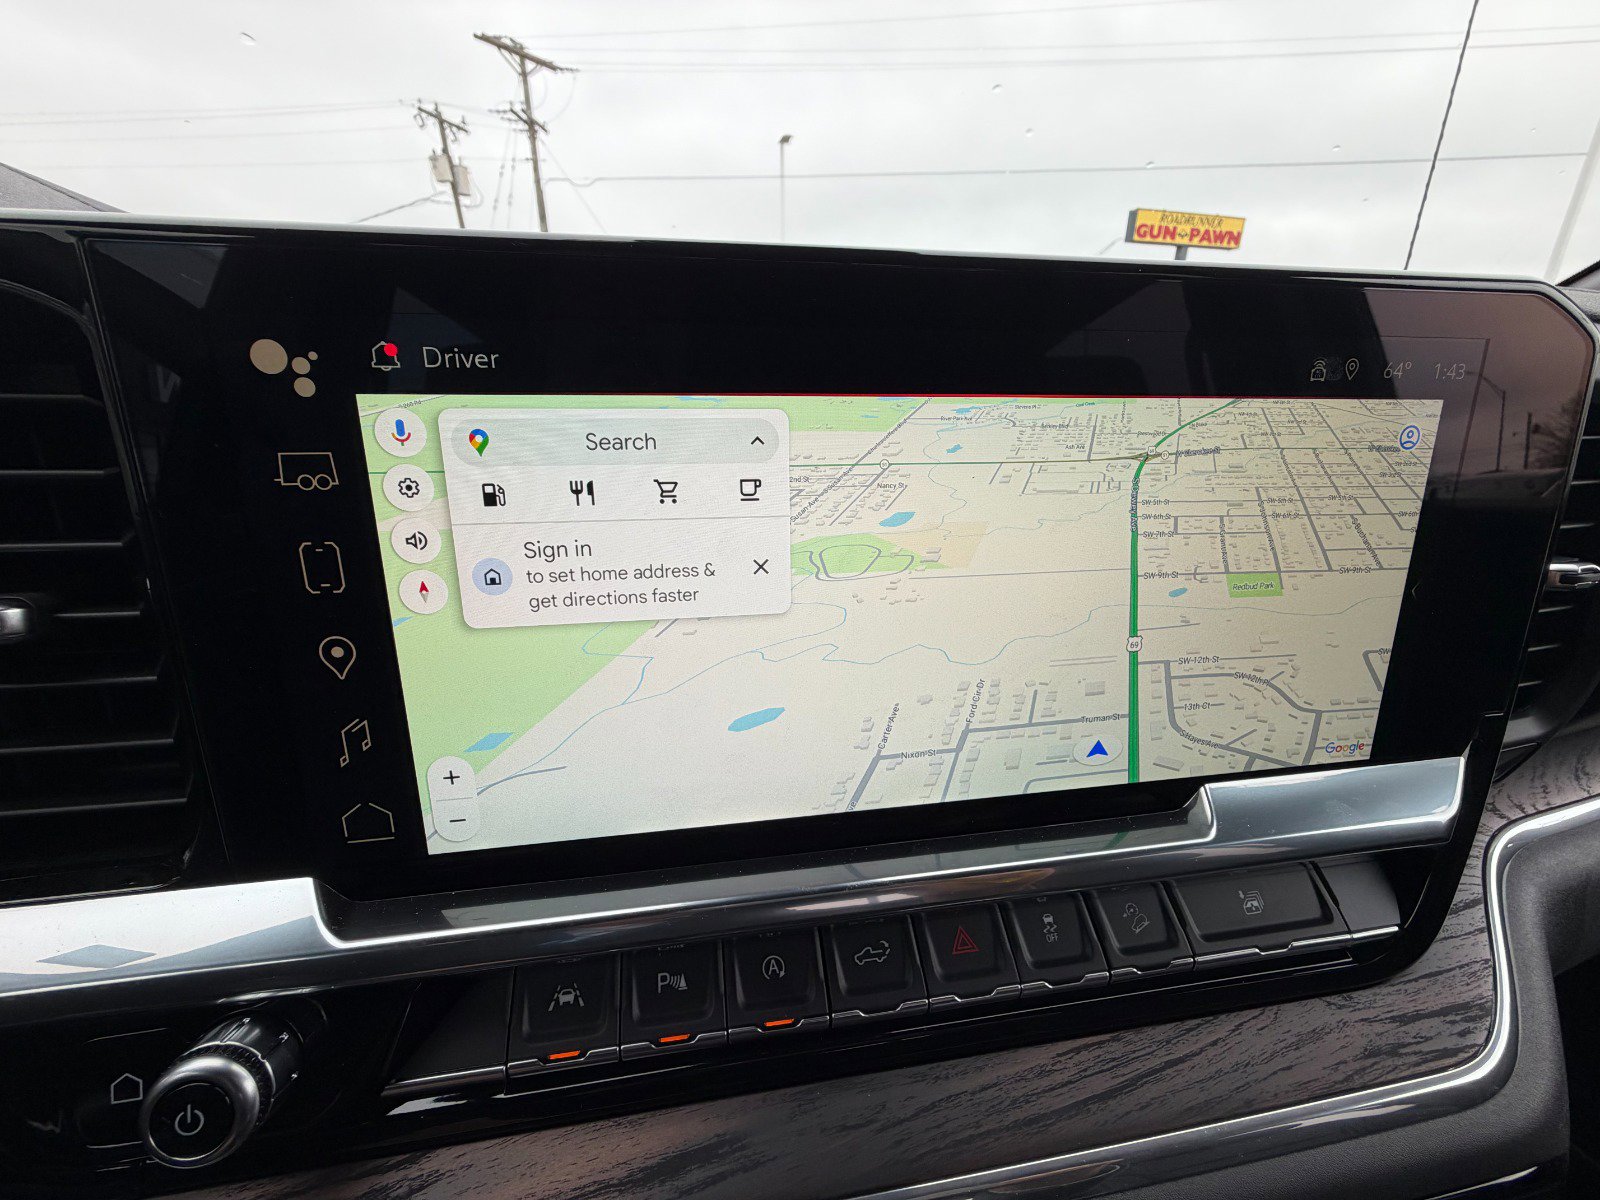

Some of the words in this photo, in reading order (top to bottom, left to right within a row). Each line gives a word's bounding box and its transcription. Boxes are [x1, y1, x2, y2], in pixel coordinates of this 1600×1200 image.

[1136, 224, 1177, 240] GUN
[1189, 228, 1242, 246] PAWN
[422, 346, 499, 369] Driver
[1383, 361, 1413, 379] 64°
[1434, 362, 1466, 381] 1:43
[585, 431, 657, 451] Search
[877, 482, 896, 490] Nancy
[790, 506, 808, 523] Susan
[524, 541, 568, 562] Sign
[574, 540, 592, 557] in
[526, 568, 544, 585] to
[549, 567, 576, 583] set
[580, 563, 629, 582] home
[633, 562, 699, 580] address
[704, 562, 716, 578] &
[1232, 583, 1258, 591] Redbud
[1260, 582, 1274, 590] Park
[529, 593, 558, 613] get
[563, 589, 648, 608] directions
[652, 588, 700, 604] faster
[1130, 641, 1139, 649] 69
[1178, 657, 1192, 665] SW
[1194, 656, 1210, 664] 12th
[976, 678, 986, 689] Dr
[1234, 671, 1246, 680] SW
[1247, 673, 1262, 685] 12th
[973, 690, 982, 703] Cir
[965, 703, 977, 723] Ford
[1184, 703, 1200, 711] 13th
[1202, 702, 1210, 710] Ct
[1081, 714, 1109, 723] Truman
[1112, 713, 1120, 721] St
[878, 721, 892, 750] Carter
[888, 705, 900, 723] Ave
[1185, 732, 1205, 747] Hayes
[1205, 739, 1218, 749] Ave
[1325, 741, 1365, 755] Google
[901, 750, 925, 759] Nixon
[928, 749, 936, 757] St
[1046, 932, 1058, 942] OFF
